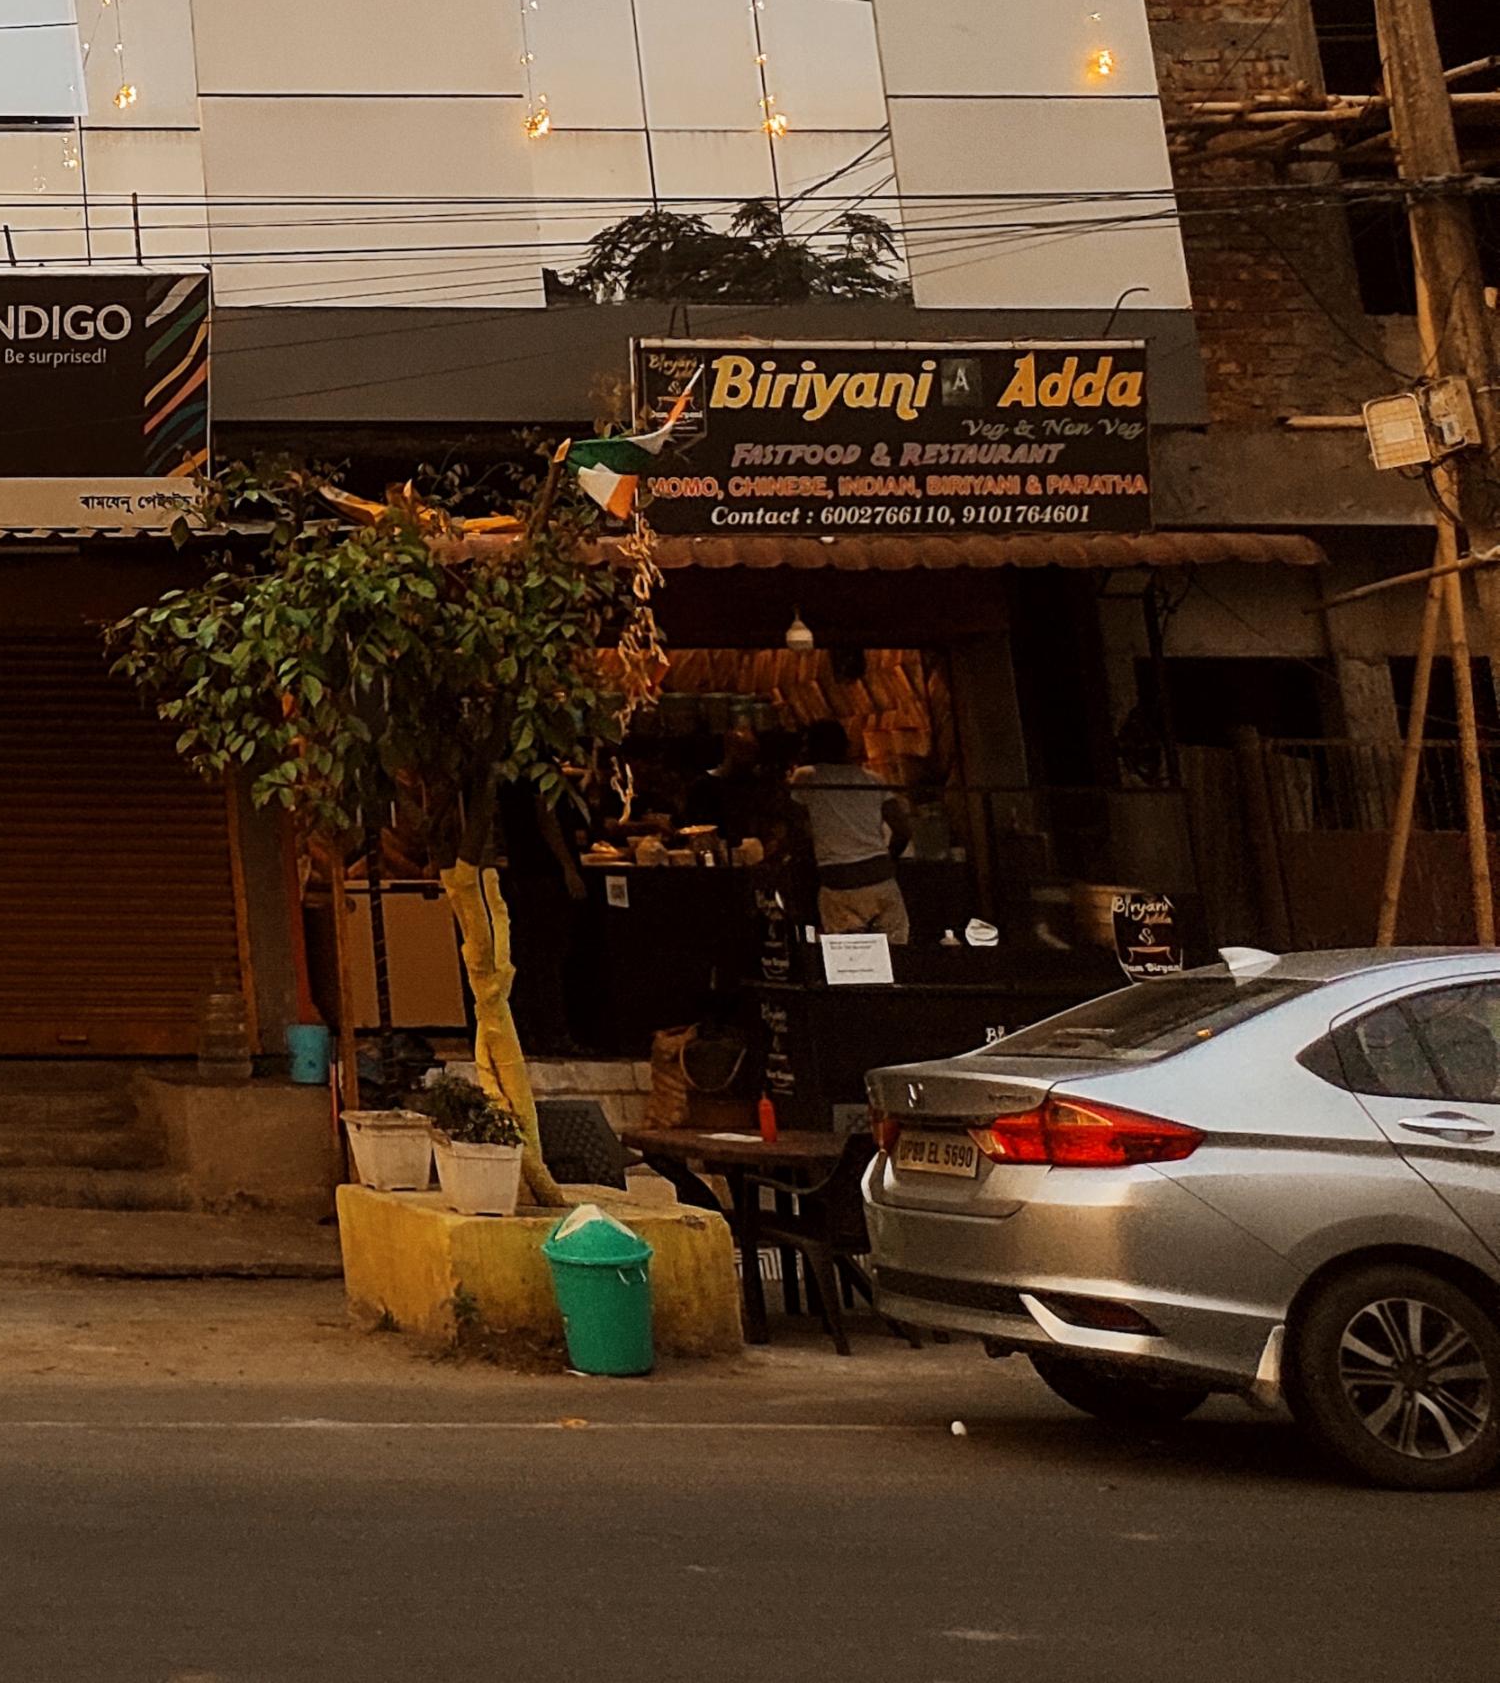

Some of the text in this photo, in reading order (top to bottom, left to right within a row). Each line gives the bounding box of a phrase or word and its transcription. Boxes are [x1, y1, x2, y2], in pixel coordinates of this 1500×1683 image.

[4, 348, 107, 368] Be surprised!
[709, 355, 937, 421] Biriyani
[996, 351, 1144, 409] Adda
[962, 419, 1146, 439] Veg & Non Veg
[870, 442, 892, 466] &
[838, 476, 922, 498] INDIAN,
[926, 475, 1022, 496] BIRIYANI
[1025, 476, 1043, 496] &
[1046, 474, 1149, 495] PARATHA
[710, 506, 800, 526] Contact
[819, 506, 955, 526] 6002766110,
[961, 505, 1091, 524] 9101764601
[928, 1141, 940, 1164] EL
[944, 1143, 973, 1168] 5690
